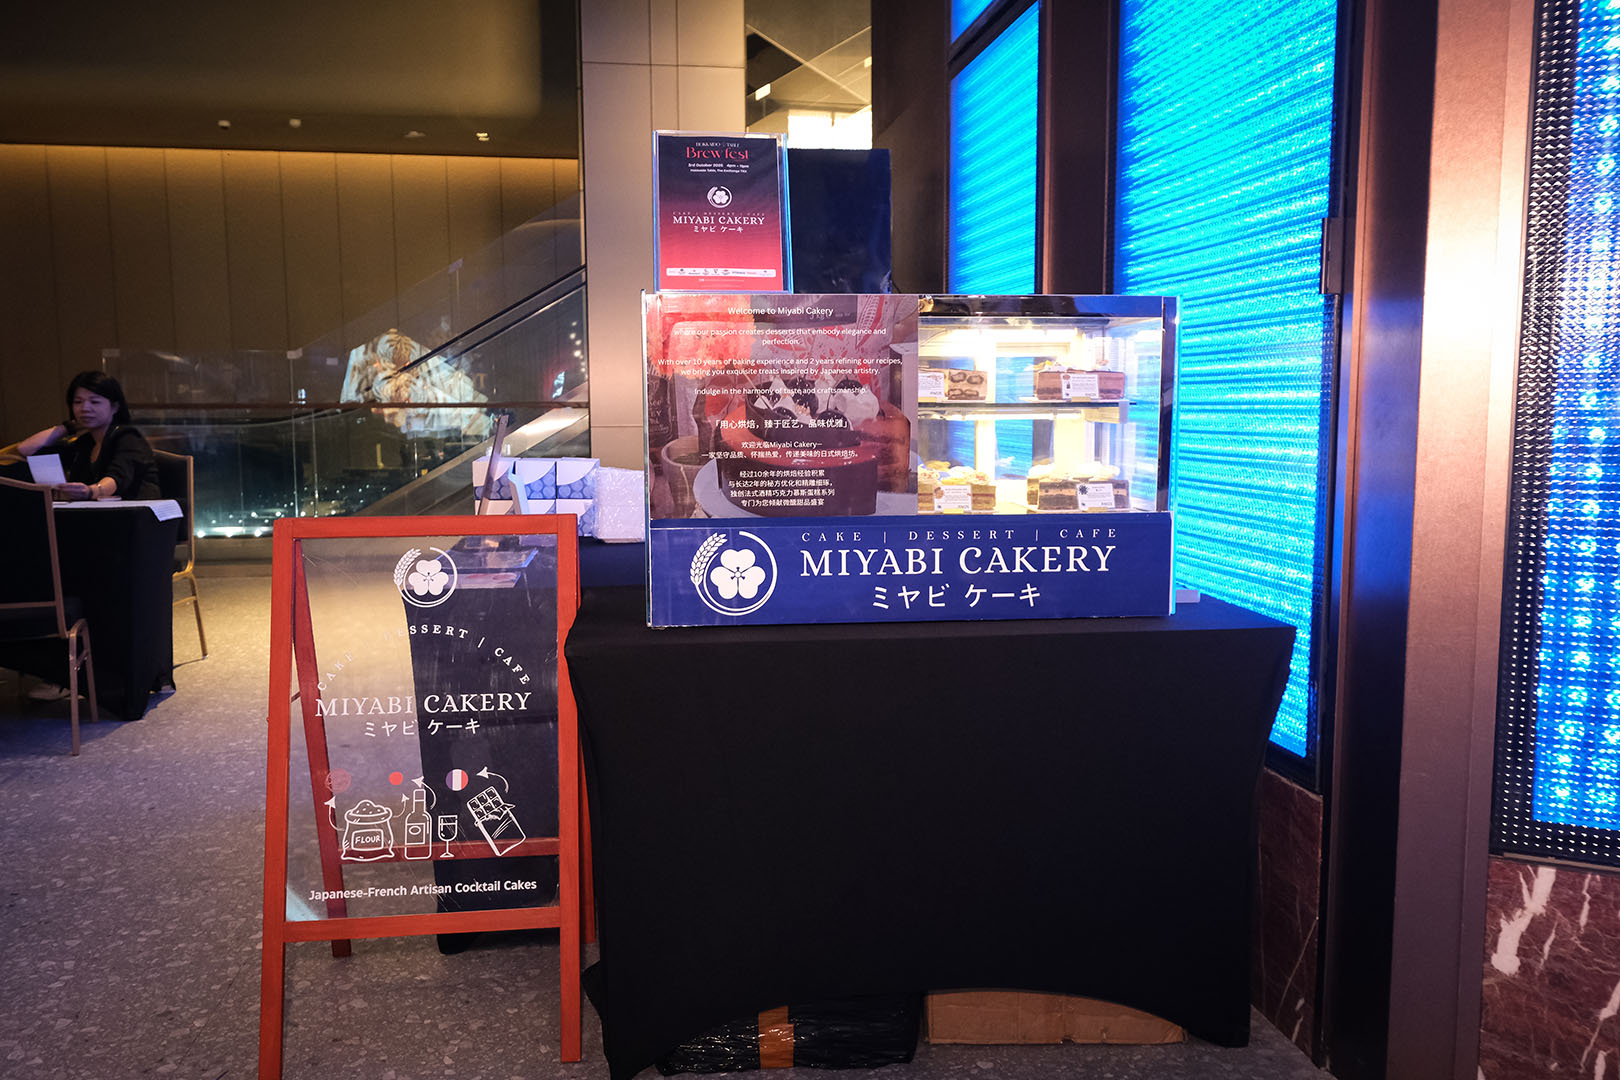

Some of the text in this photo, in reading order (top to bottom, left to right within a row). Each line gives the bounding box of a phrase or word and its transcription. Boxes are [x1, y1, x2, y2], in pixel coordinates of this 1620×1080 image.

[672, 216, 765, 225] MIYABI CAKERY
[693, 225, 744, 233] ミヤビ ケーキ
[728, 307, 766, 315] Welcome
[777, 307, 805, 316] Miyabi
[805, 307, 834, 316] Cakery
[710, 328, 737, 336] passion
[811, 328, 840, 336] embody
[841, 328, 872, 336] elegance
[657, 358, 675, 366] With
[703, 359, 723, 367] years
[732, 358, 756, 367] baking
[756, 358, 795, 367] experience
[815, 358, 835, 366] years
[835, 357, 862, 366] refining
[692, 368, 711, 376] bring
[726, 368, 758, 376] exquisite
[780, 367, 809, 376] inspired
[809, 367, 819, 376] by
[820, 367, 853, 376] Japanese
[694, 388, 721, 397] Indulge
[742, 388, 774, 396] harmony
[801, 532, 864, 543] CAKE
[908, 530, 1018, 541] DESSERT
[1059, 528, 1119, 539] CAFE
[800, 545, 1117, 577] MIYABI CAKERY
[872, 583, 1042, 609] ミヤビ ケーキ
[494, 646, 532, 686] CAFE
[315, 692, 533, 718] MIYABI CAKERY
[364, 717, 481, 738] ミヤビ ケーキ
[354, 834, 382, 844] FLOUR
[308, 878, 538, 902] Japanese-French Artisan Cocktail Cakes
